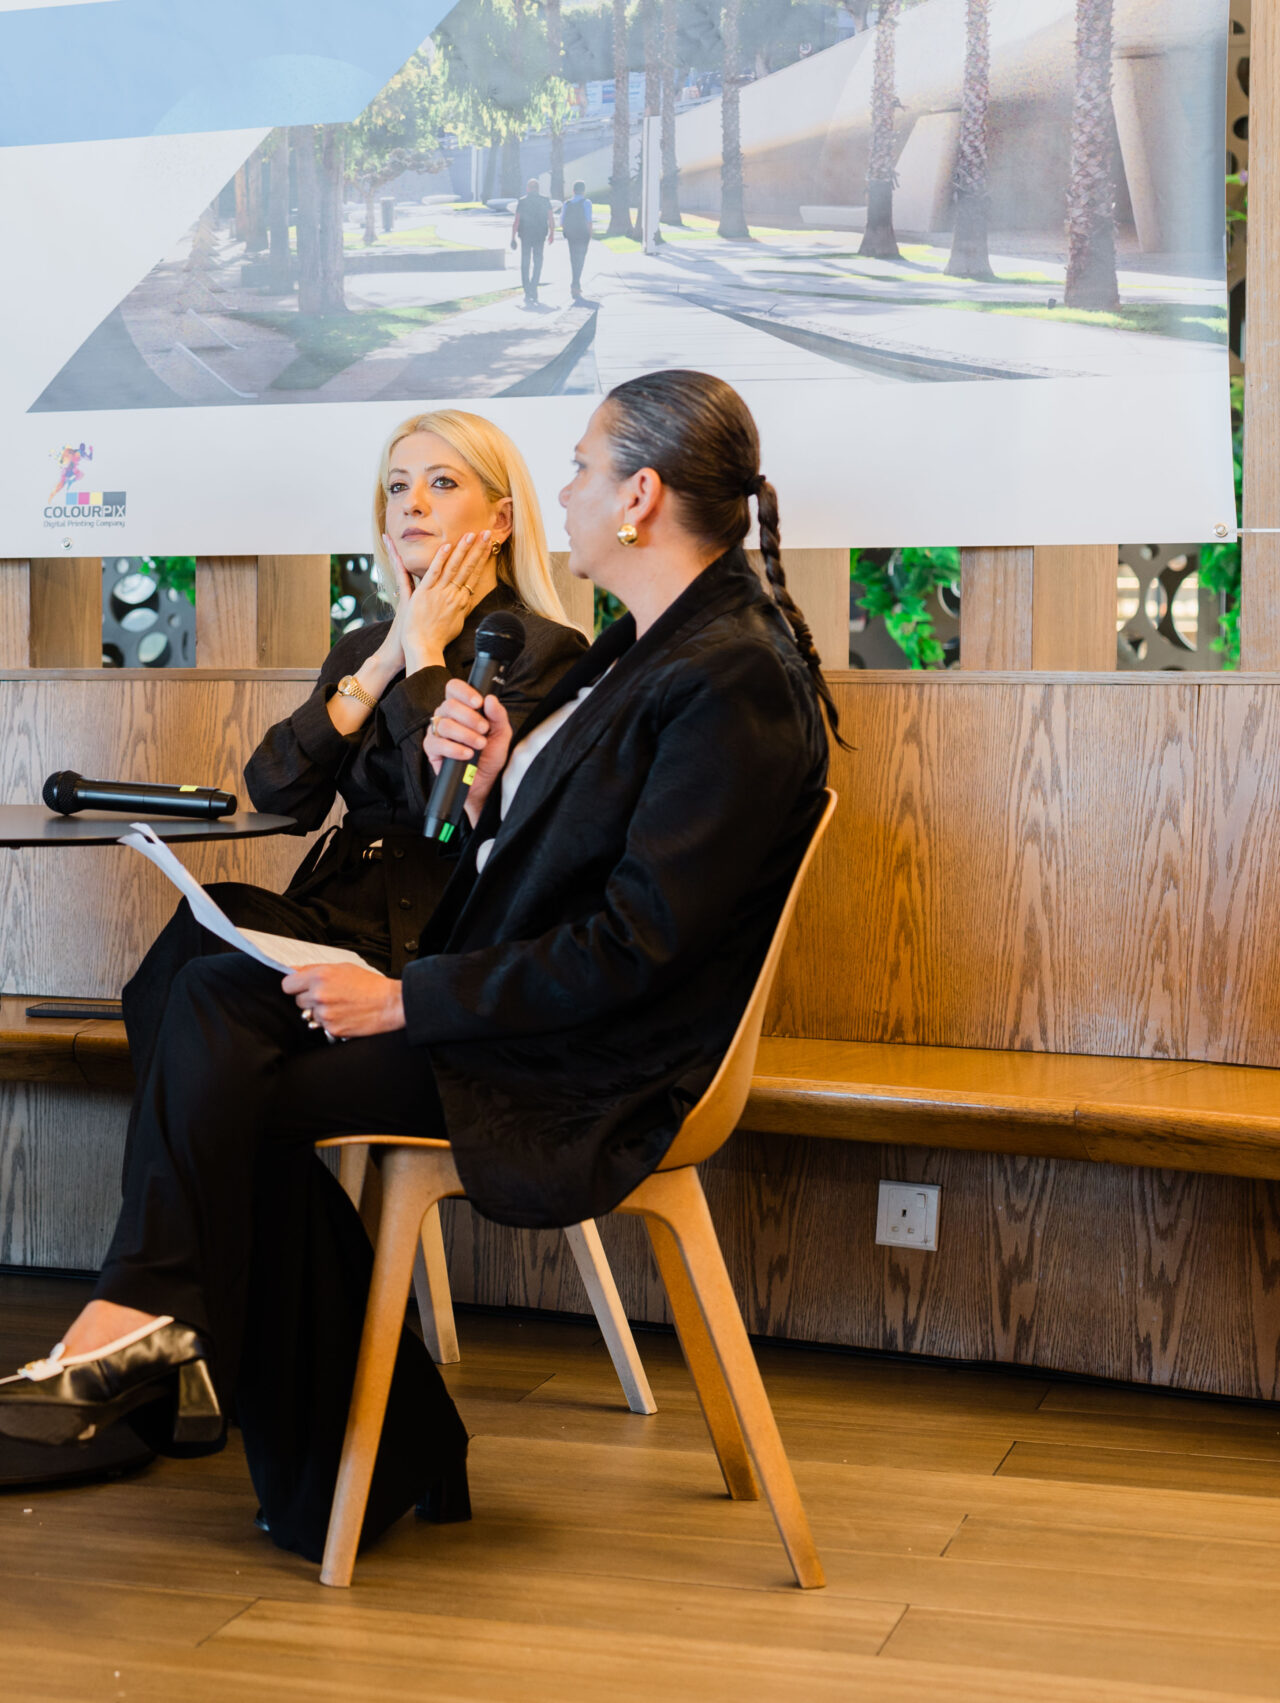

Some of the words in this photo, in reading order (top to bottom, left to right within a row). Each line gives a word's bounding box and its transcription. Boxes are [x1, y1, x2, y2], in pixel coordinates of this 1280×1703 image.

[43, 504, 126, 518] COLOURPIX
[43, 520, 66, 529] Digital
[67, 519, 94, 528] Printing
[96, 519, 125, 528] Company
